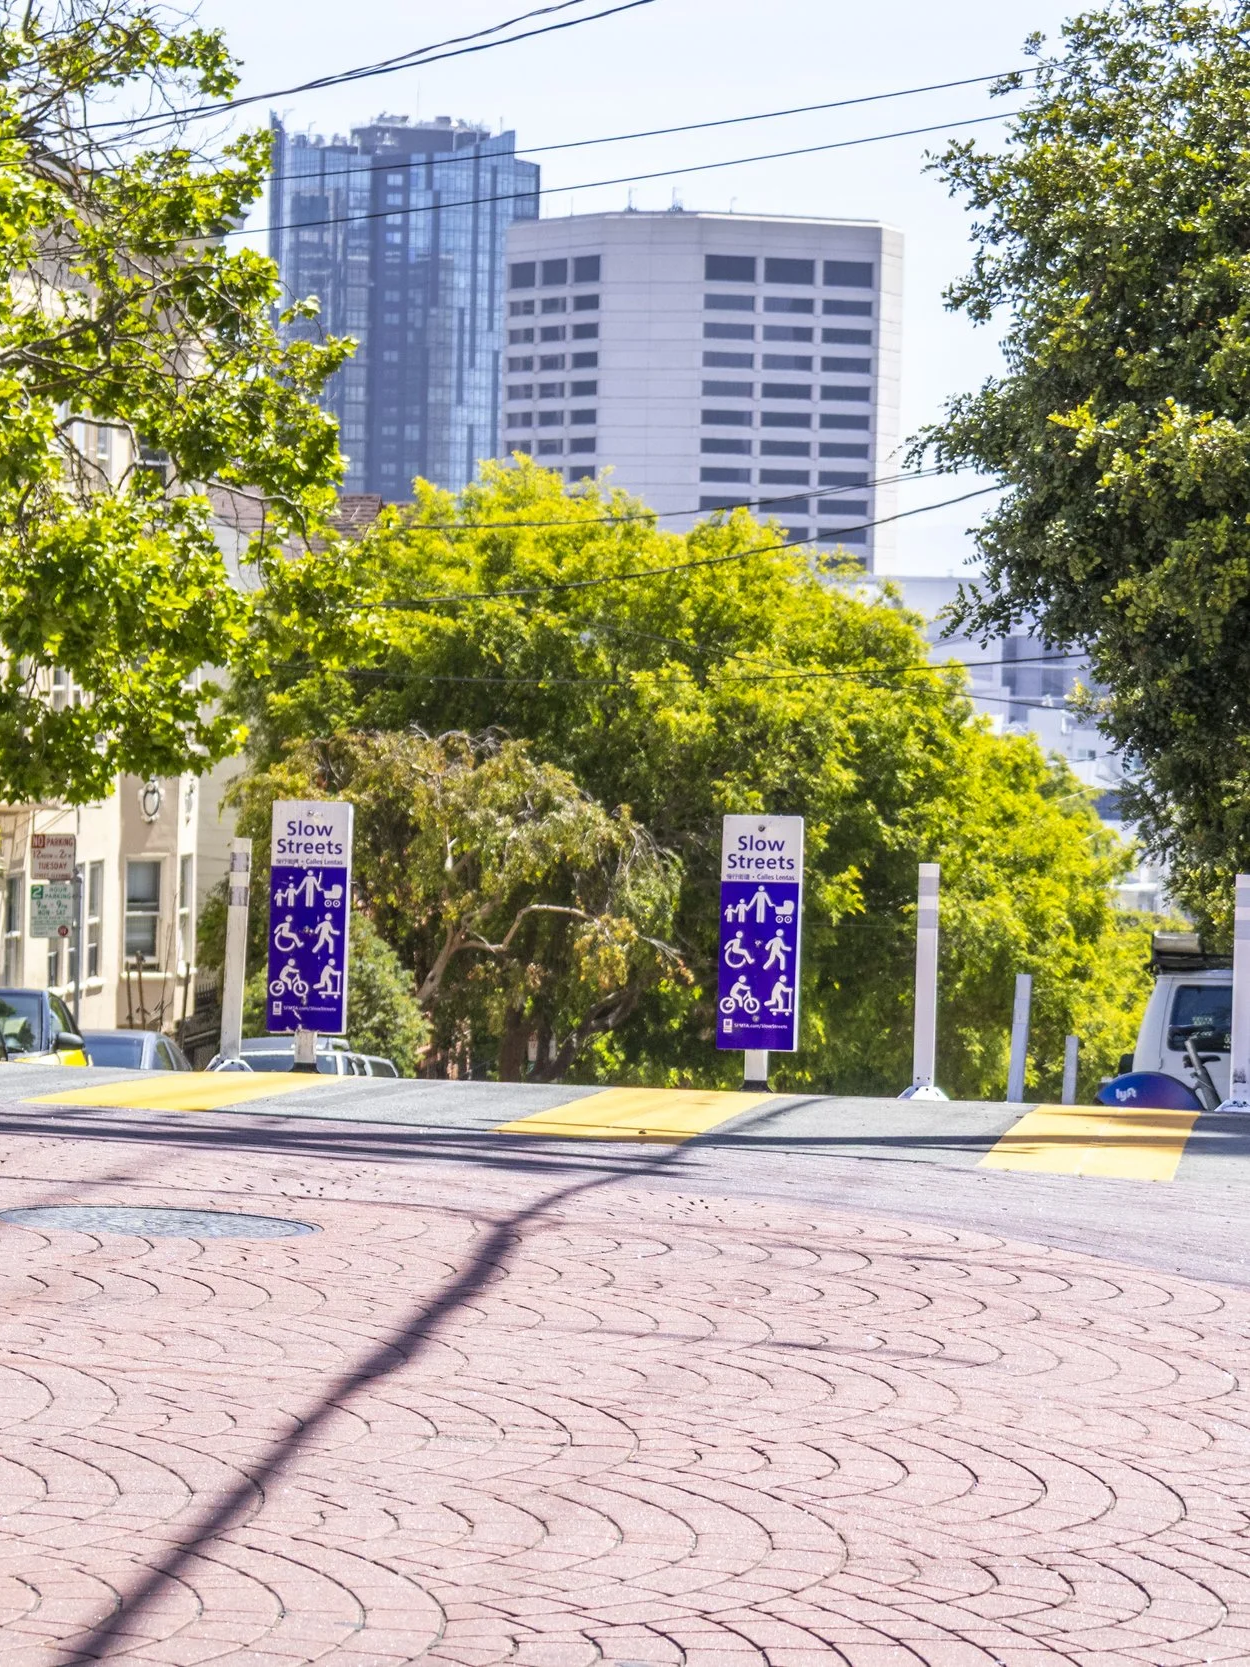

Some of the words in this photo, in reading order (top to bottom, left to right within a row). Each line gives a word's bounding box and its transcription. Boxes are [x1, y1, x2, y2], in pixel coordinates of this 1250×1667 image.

[287, 820, 333, 836] Slow
[33, 835, 44, 846] NO
[46, 838, 73, 846] PARKING
[277, 839, 343, 854] Streets
[738, 835, 785, 851] Slow
[727, 854, 795, 869] Streets
[32, 887, 42, 898] 2
[1115, 1087, 1137, 1101] lyft
